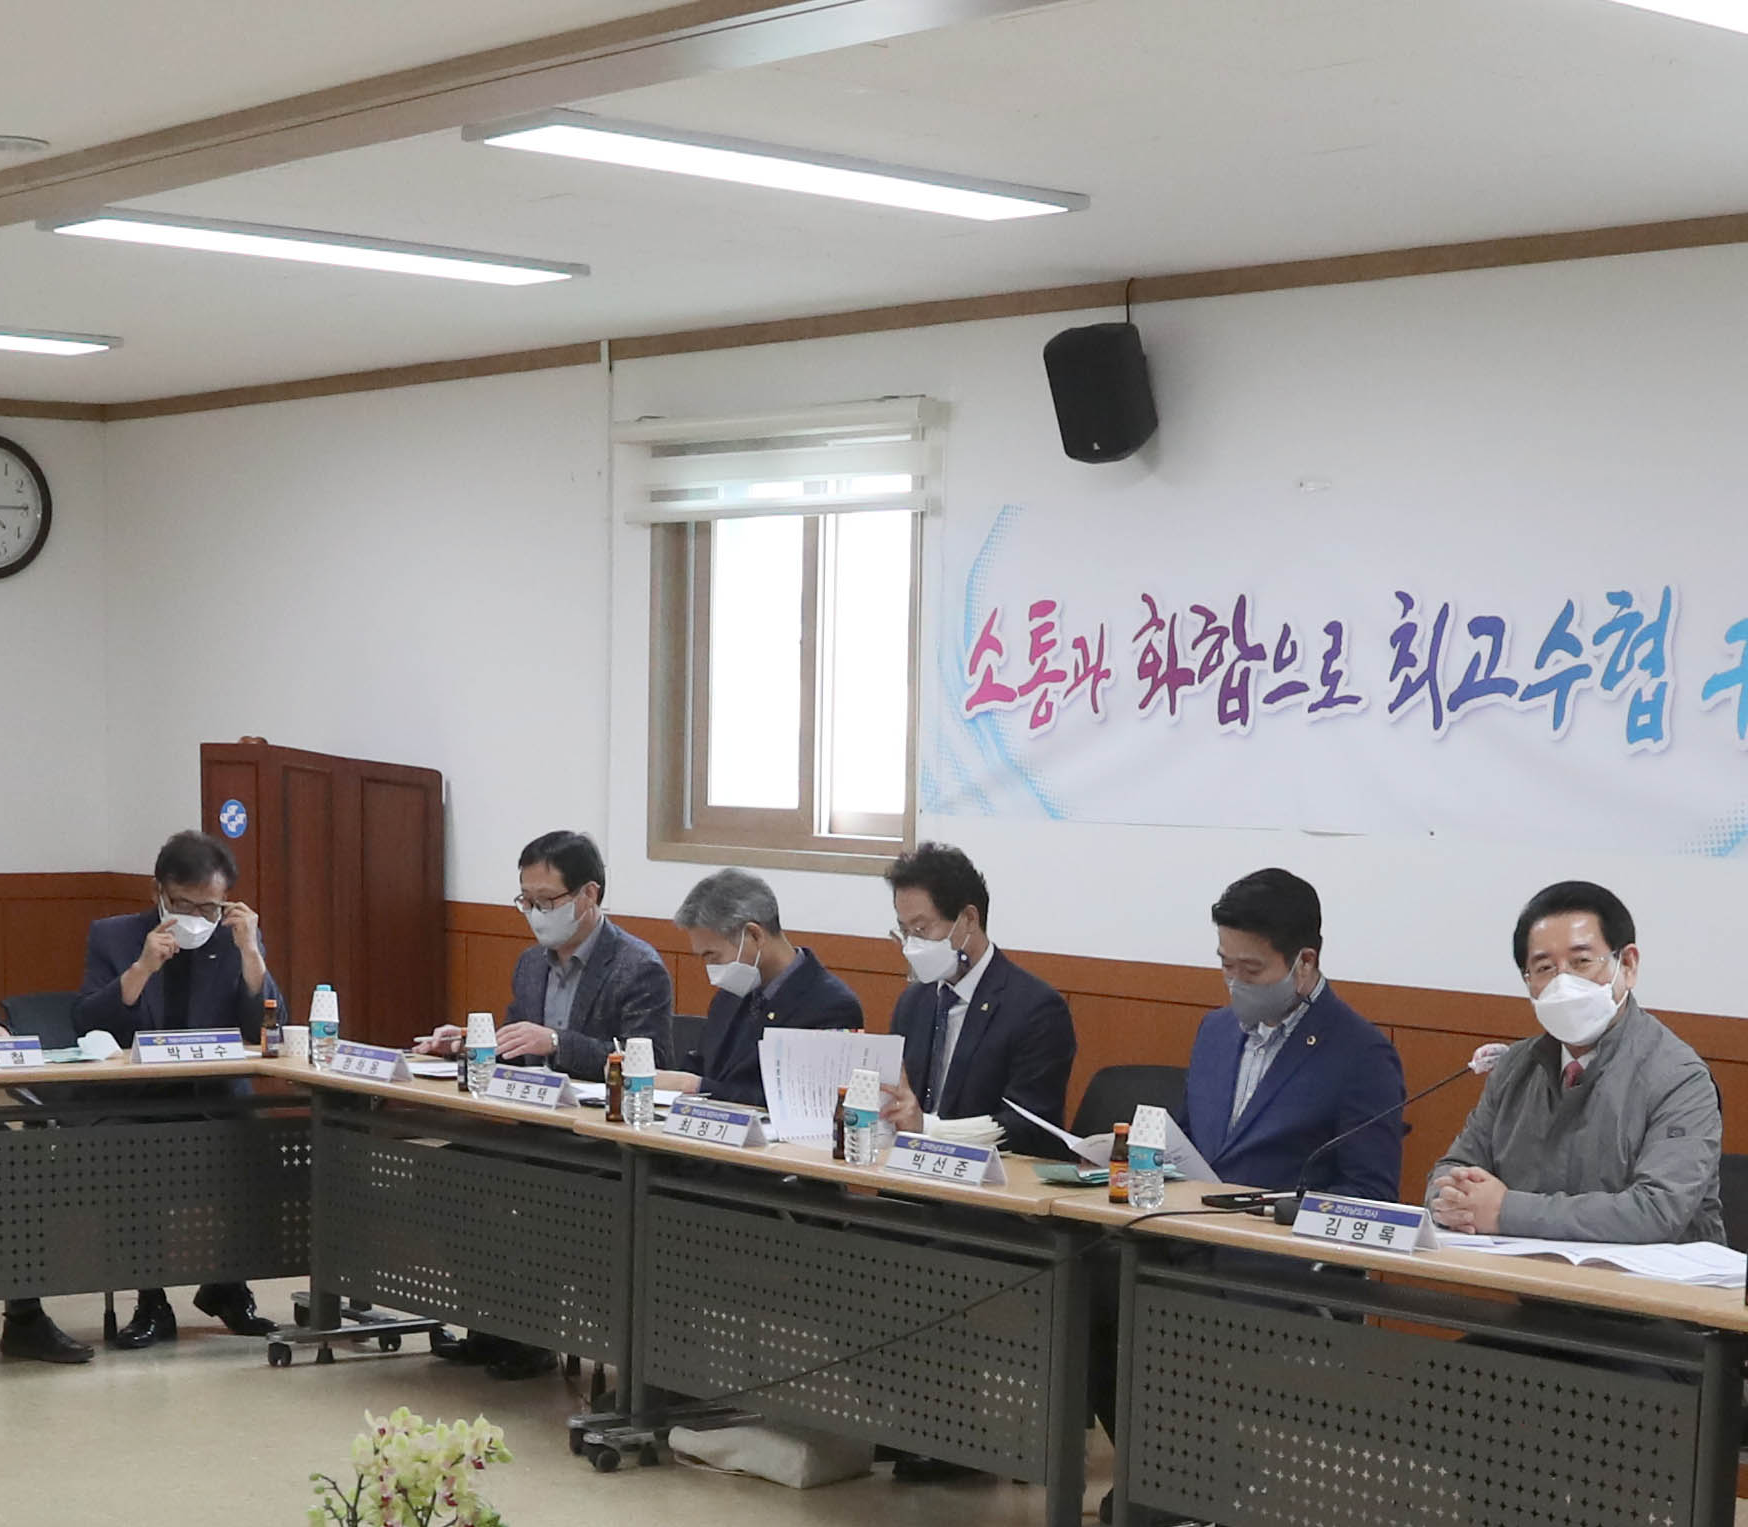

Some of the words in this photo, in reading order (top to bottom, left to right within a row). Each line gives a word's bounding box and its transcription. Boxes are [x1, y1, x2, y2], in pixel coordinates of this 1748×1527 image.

[15, 480, 24, 493] 2
[966, 599, 1114, 733] 소통과
[1132, 592, 1364, 727] 화합으로
[1387, 586, 1674, 746] 최고수협
